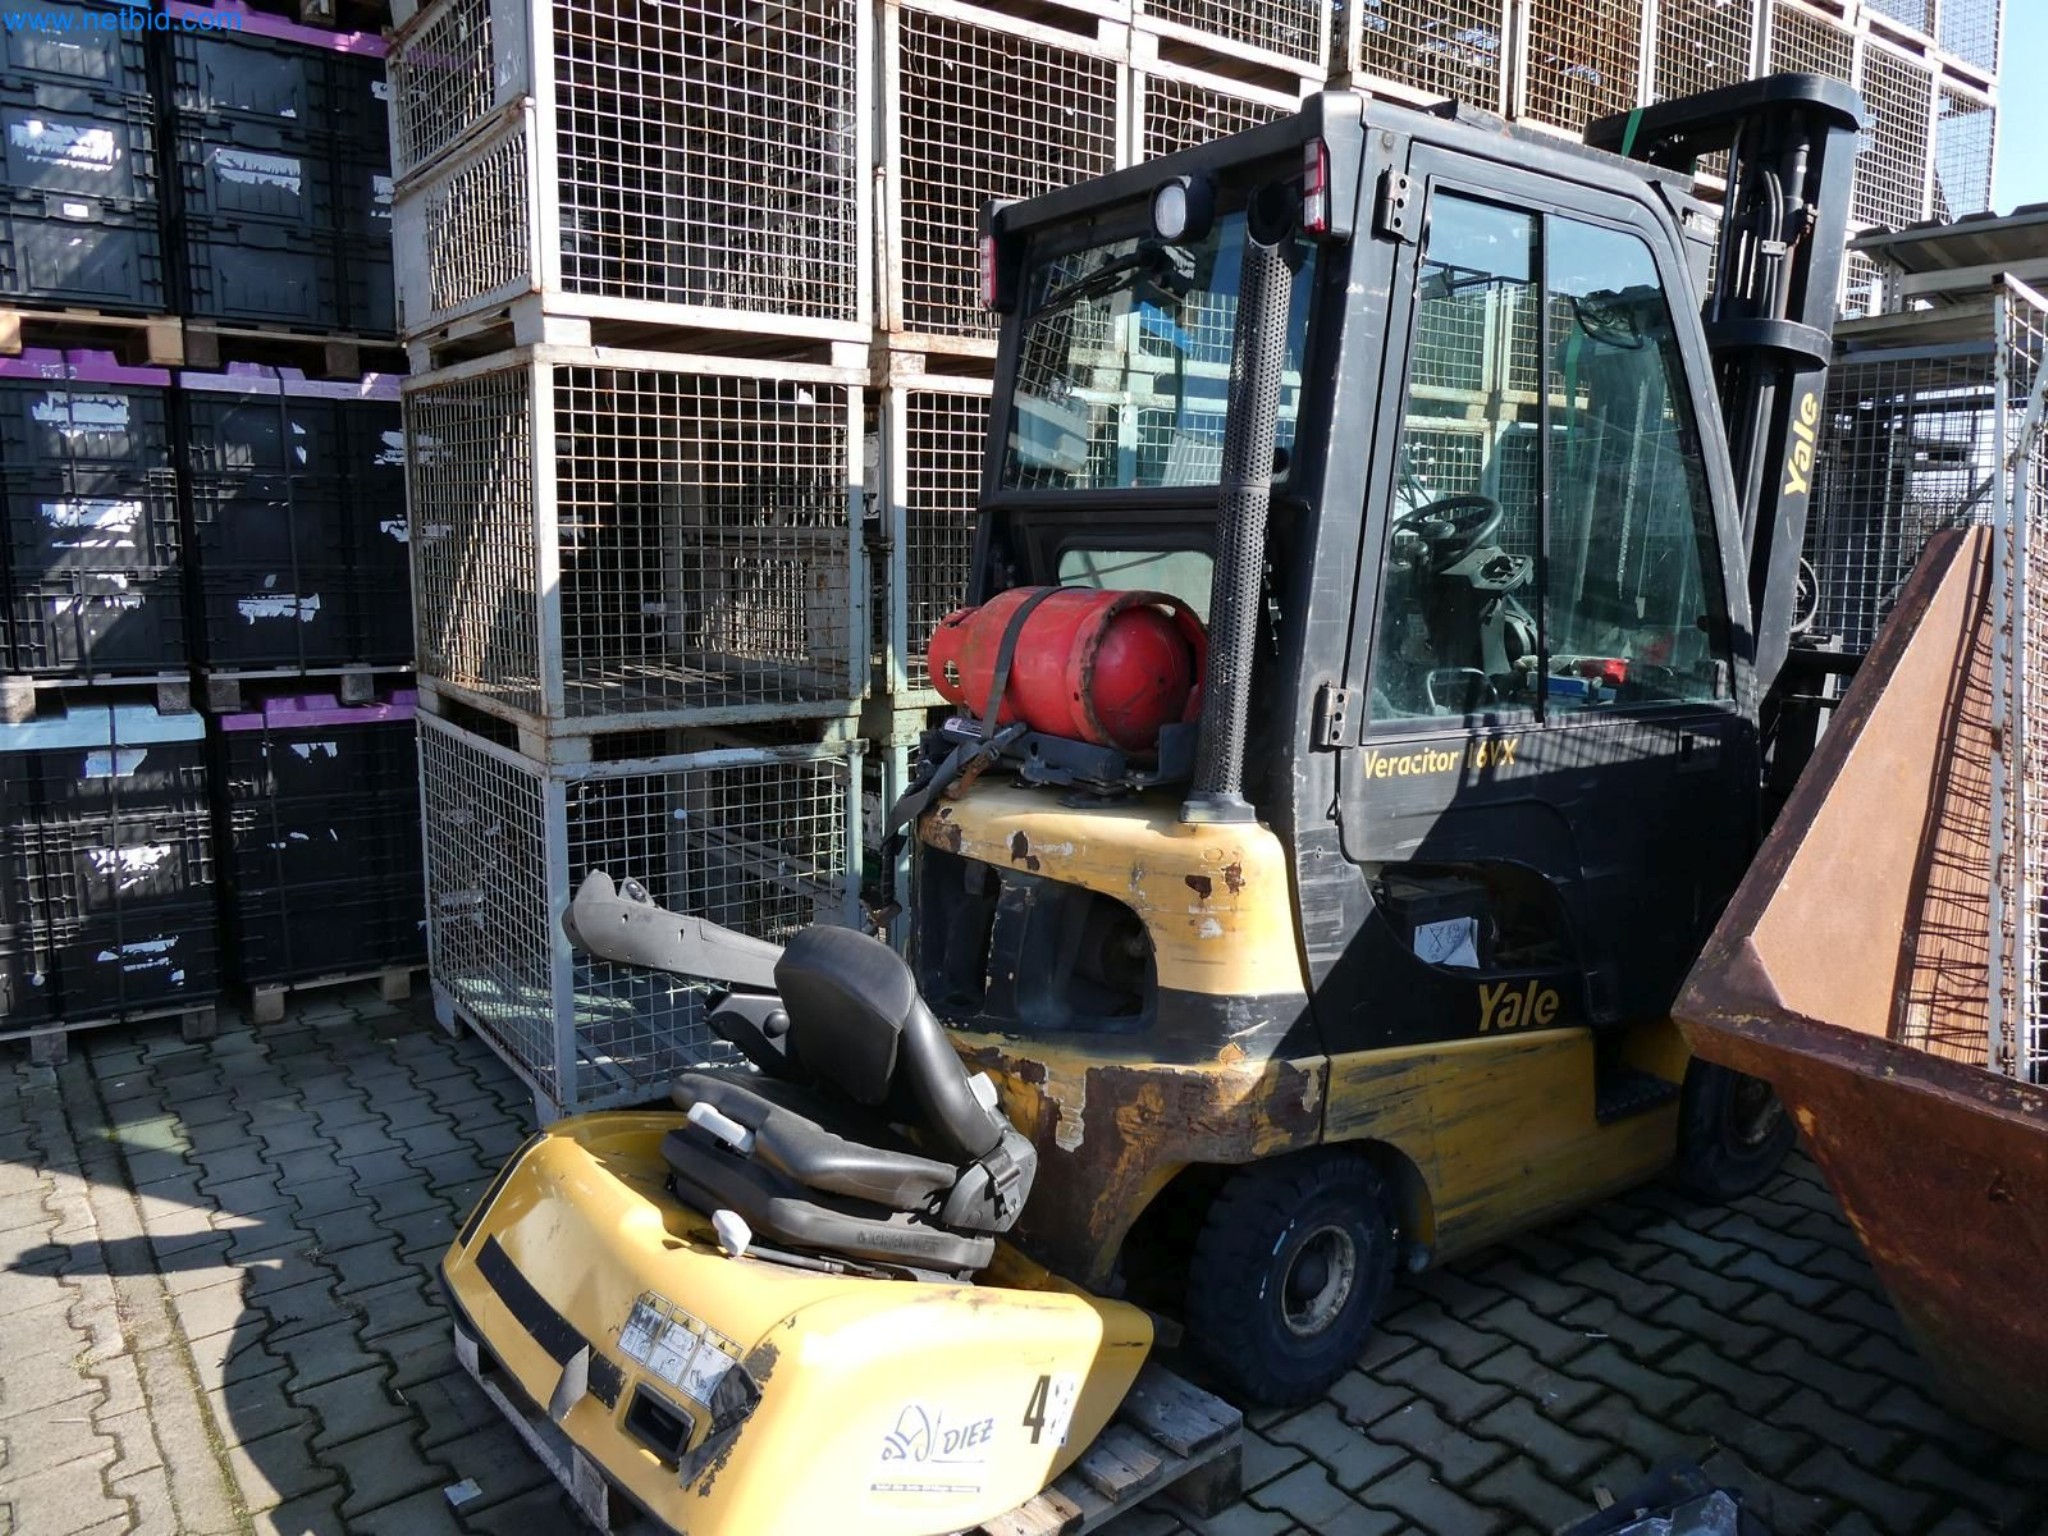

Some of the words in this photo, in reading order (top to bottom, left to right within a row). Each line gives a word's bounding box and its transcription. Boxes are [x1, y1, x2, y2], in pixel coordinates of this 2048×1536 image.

[1783, 392, 1818, 495] Yale
[1364, 747, 1459, 779] Veracitor
[1478, 979, 1559, 1032] Yale
[943, 1418, 994, 1455] DIEZ
